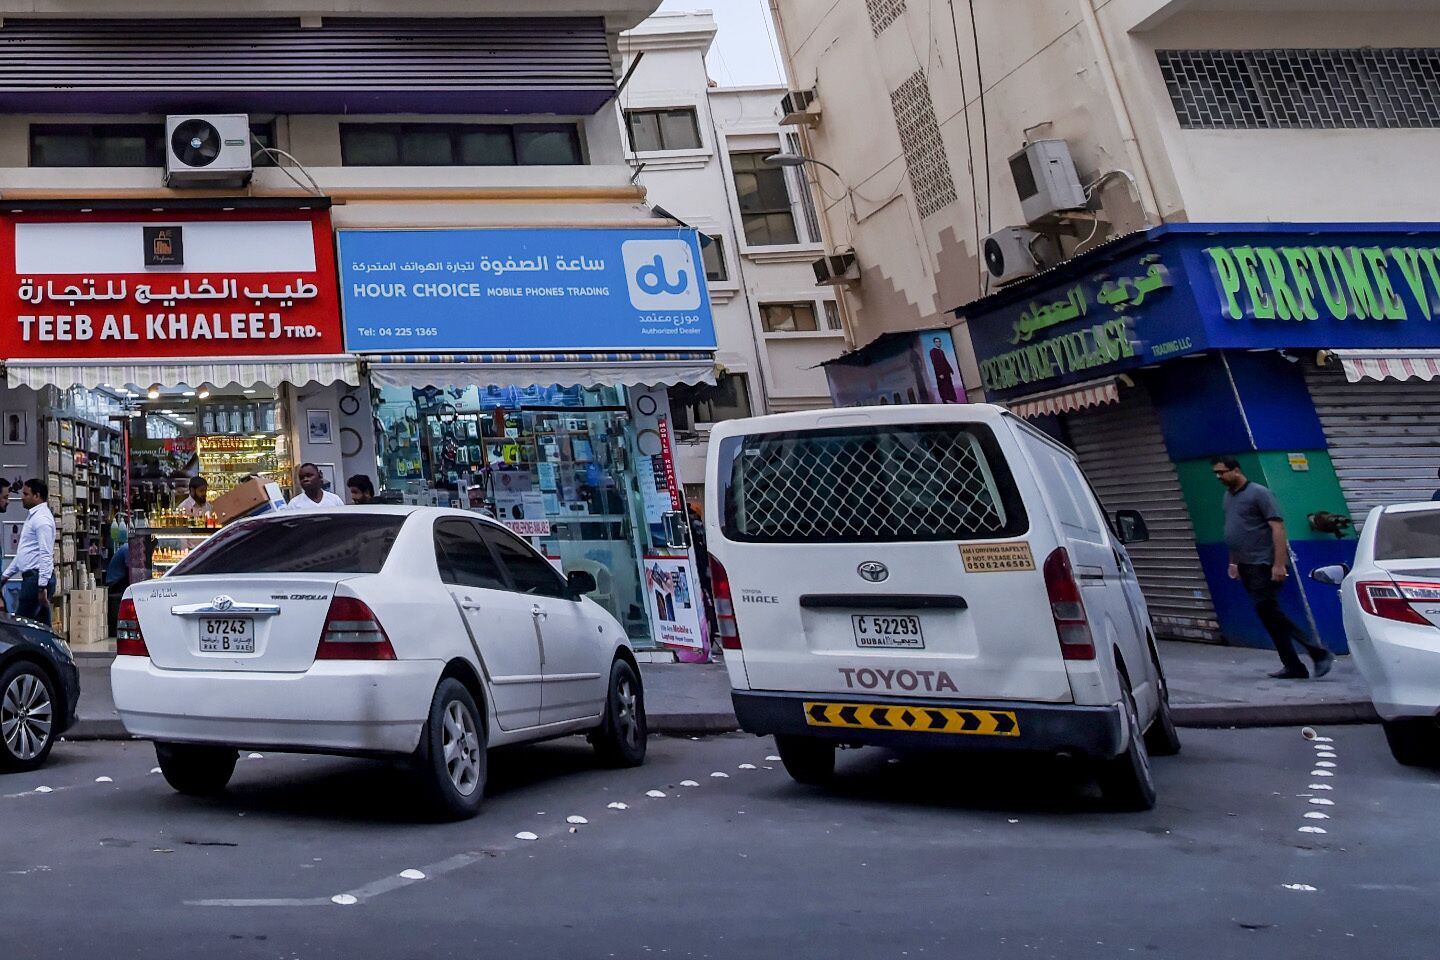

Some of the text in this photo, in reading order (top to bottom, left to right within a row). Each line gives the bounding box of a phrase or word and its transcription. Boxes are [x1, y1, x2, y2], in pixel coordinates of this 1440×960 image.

[446, 261, 475, 273] لتجارة
[480, 255, 549, 276] الصفوة
[556, 255, 606, 272] ساعة
[636, 254, 688, 295] du
[1206, 245, 1408, 321] PERFUME
[18, 278, 318, 307] طيب الخليج للتجارة
[353, 283, 610, 298] HOUR CHOICE MOBILE PHONES TRADING
[17, 313, 323, 341] TEEB AL KHALEEJ TRD.
[358, 326, 438, 336] Tel: 04 225 1365
[641, 327, 701, 335] Authorized Dealer
[980, 316, 1134, 391] PERFUME VILLAGE
[1151, 339, 1179, 356] TRADING
[659, 423, 670, 454] MOBILE
[665, 458, 678, 506] REPAIRING
[967, 560, 1031, 569] 0506246583
[742, 595, 779, 604] HIACE
[207, 620, 246, 634] 67243
[858, 618, 918, 635] C 52293
[222, 636, 230, 650] B
[838, 668, 959, 692] TOYOTA
